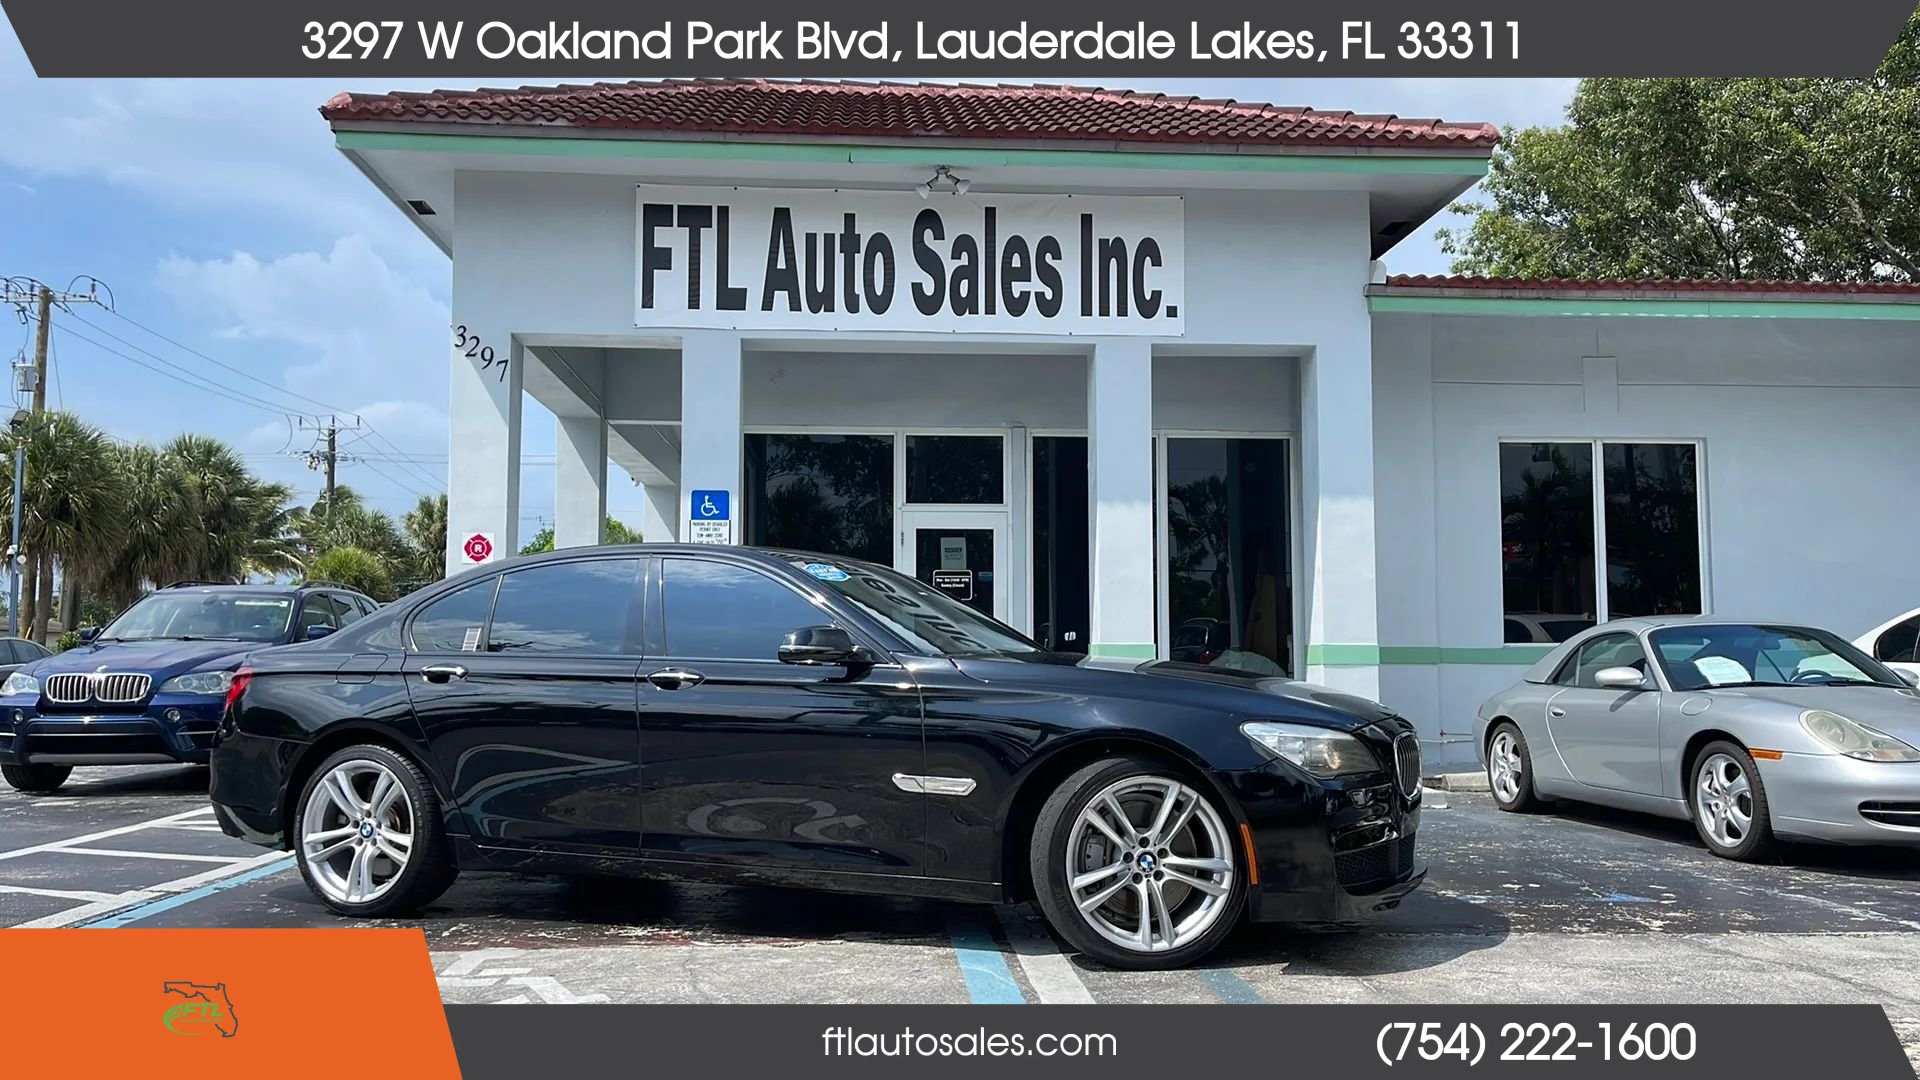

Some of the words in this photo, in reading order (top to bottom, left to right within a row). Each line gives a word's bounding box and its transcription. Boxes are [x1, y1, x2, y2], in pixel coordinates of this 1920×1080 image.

[641, 203, 748, 311] FTL
[760, 207, 896, 315] Auto
[910, 206, 1063, 317] Sales
[1080, 213, 1178, 319] Inc.
[454, 325, 509, 383] 3297
[474, 544, 483, 553] R
